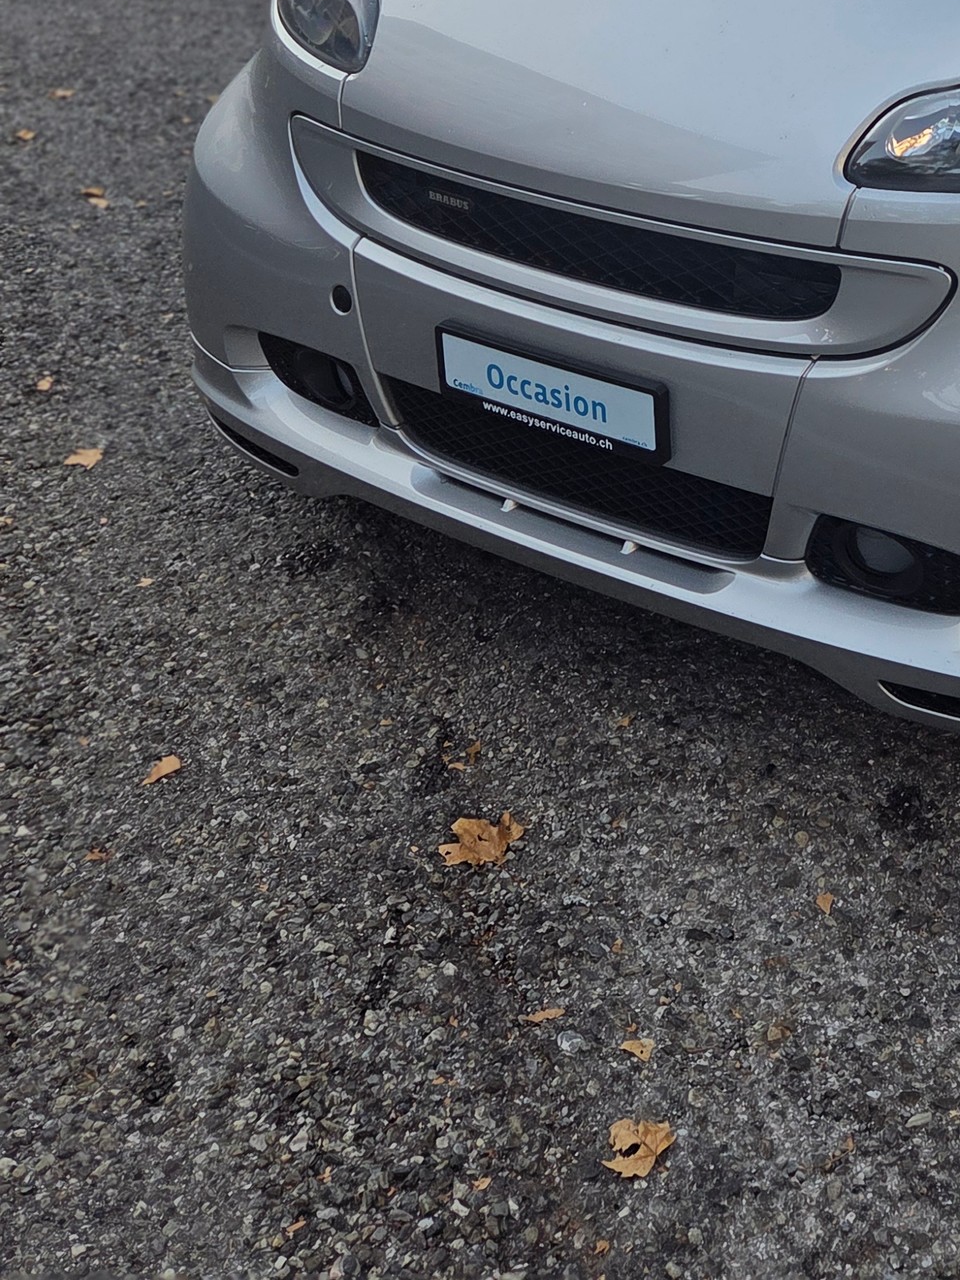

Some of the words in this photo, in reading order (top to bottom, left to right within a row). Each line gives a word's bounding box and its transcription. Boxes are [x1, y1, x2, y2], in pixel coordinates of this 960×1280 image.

[428, 190, 469, 210] BRABUS
[453, 378, 483, 395] Cembra
[486, 363, 607, 423] Occasion
[482, 400, 613, 451] www.easyserviceauto.ch
